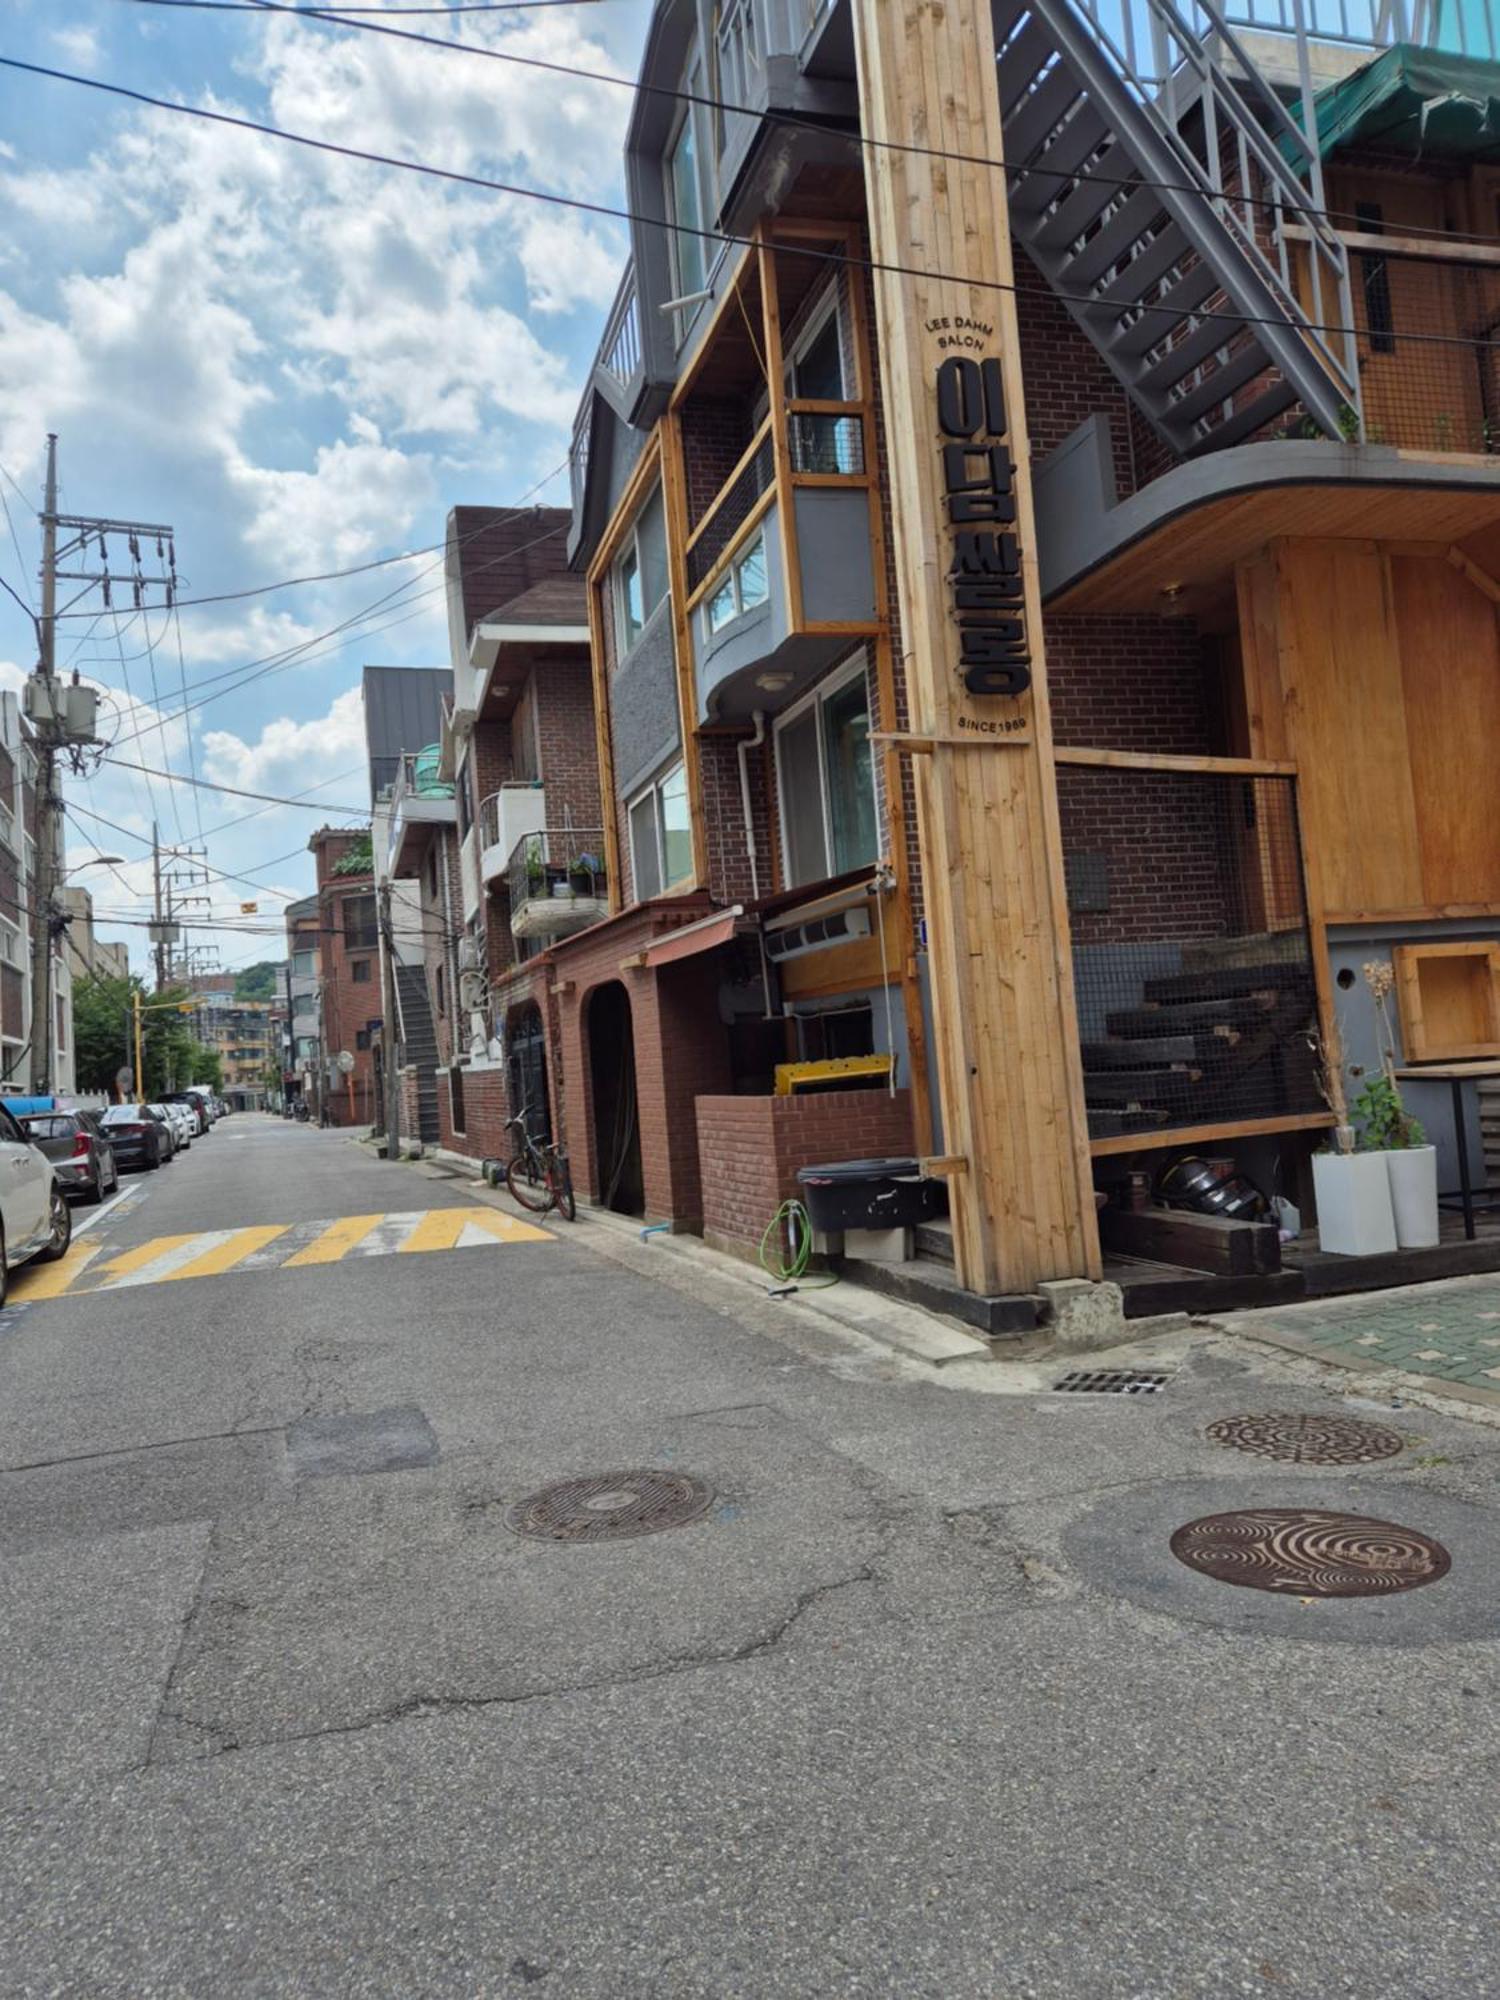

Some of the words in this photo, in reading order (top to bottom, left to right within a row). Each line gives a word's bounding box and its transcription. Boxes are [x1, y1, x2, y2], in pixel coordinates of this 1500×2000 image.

[925, 317, 951, 333] LEE
[955, 316, 993, 336] DAHM
[938, 334, 984, 351] SALON
